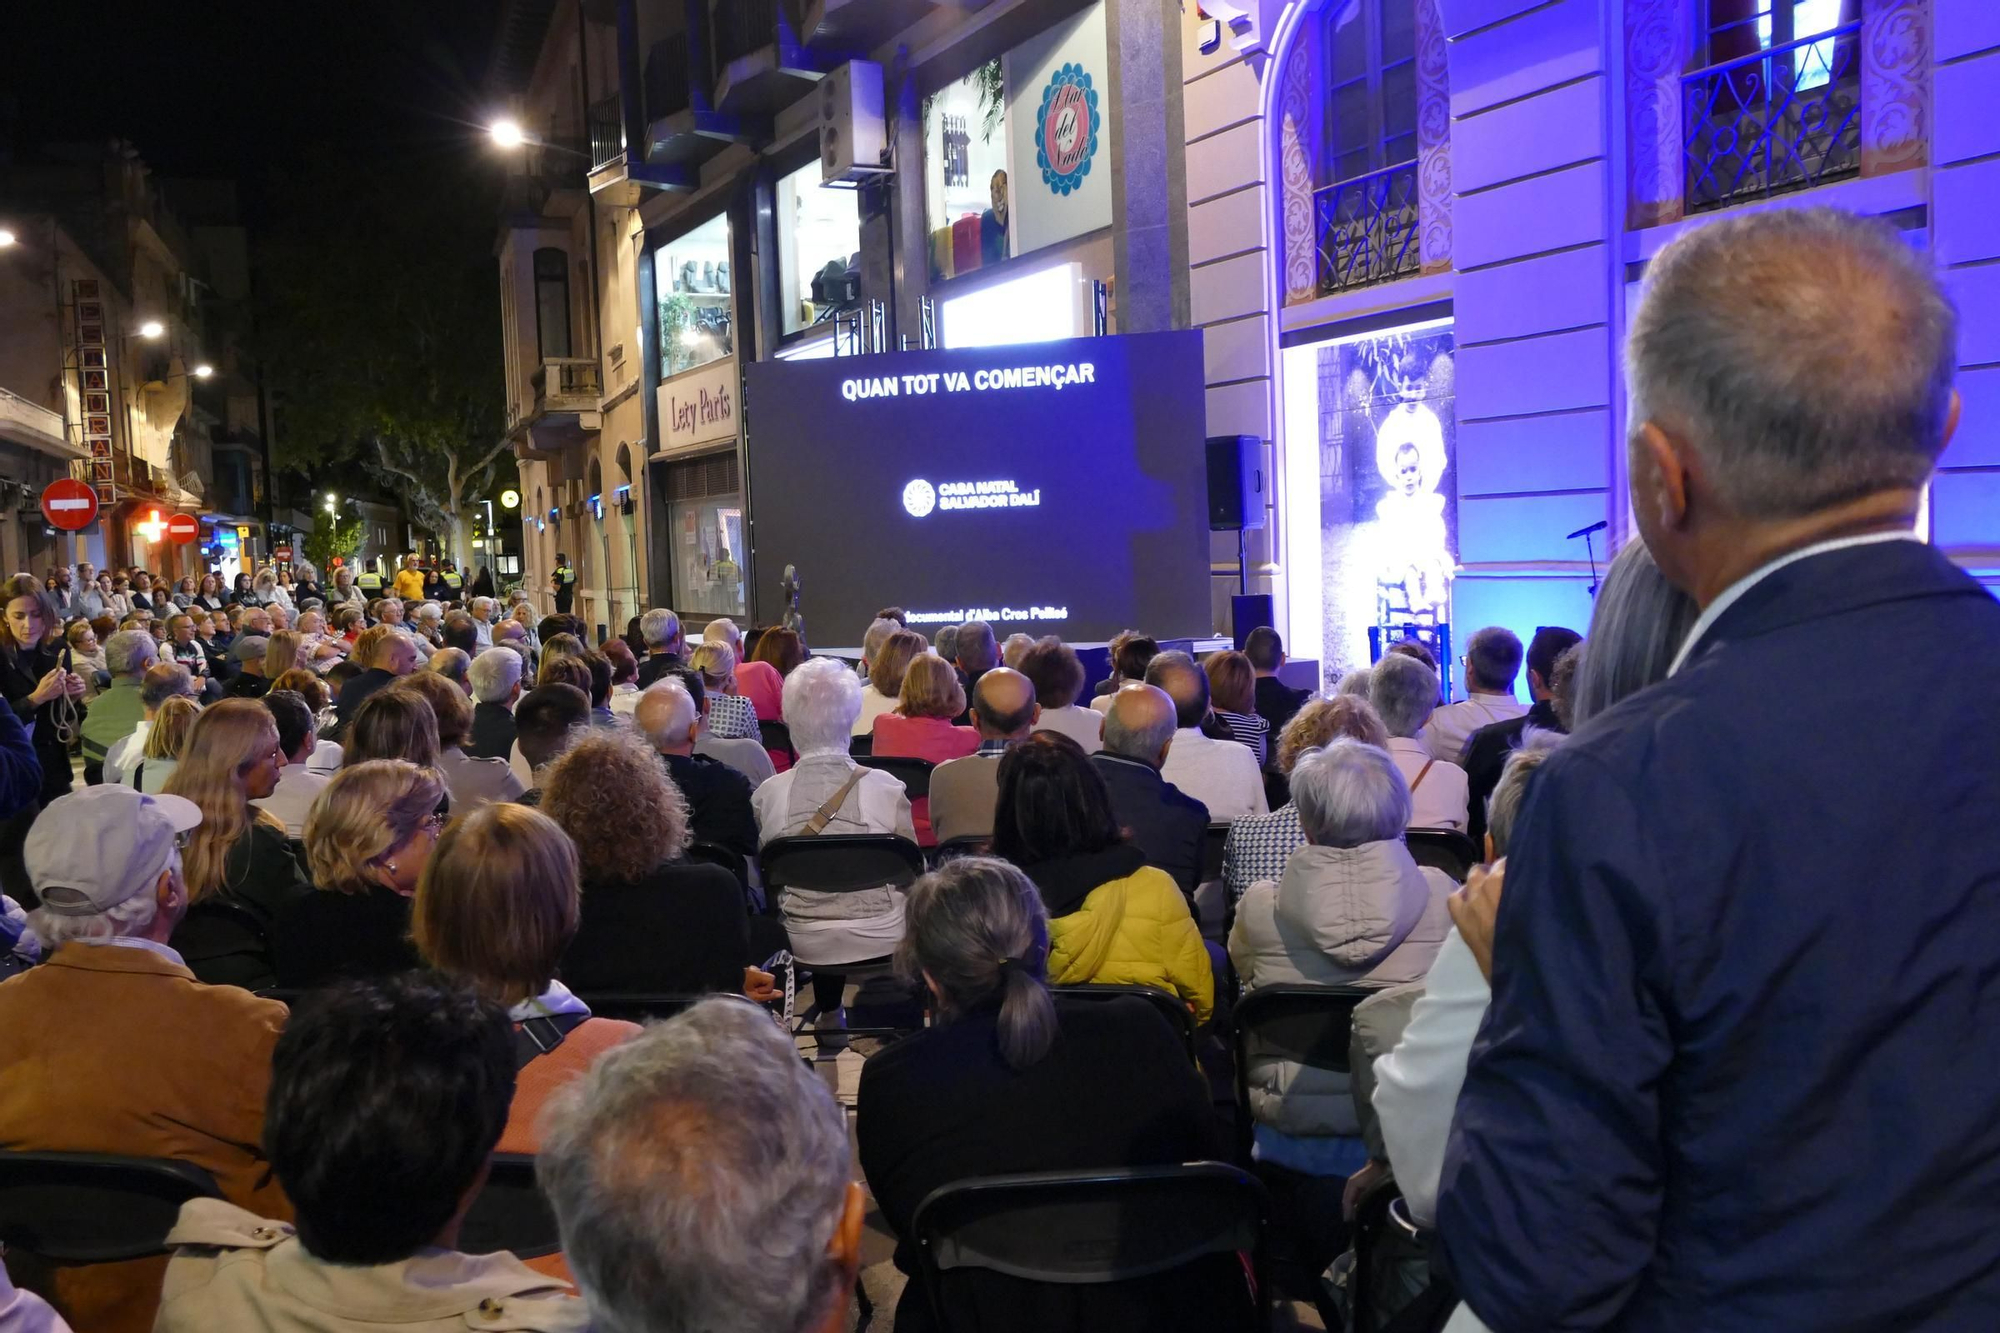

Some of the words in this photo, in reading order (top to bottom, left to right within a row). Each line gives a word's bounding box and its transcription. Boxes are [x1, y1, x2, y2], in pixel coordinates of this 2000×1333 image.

[1055, 107, 1080, 140] del
[79, 281, 112, 502] ESTAURANT
[842, 377, 898, 401] QUAN
[902, 374, 939, 394] TOT
[945, 373, 970, 392] VA
[974, 363, 1095, 390] COMENÇAR
[671, 396, 697, 436] Lety
[700, 384, 731, 425] París
[939, 482, 976, 496] CASA
[976, 481, 1019, 494] NATAL
[939, 494, 1008, 510] SALVADOR
[1009, 489, 1040, 506] DALÍ
[1001, 607, 1028, 621] Cros
